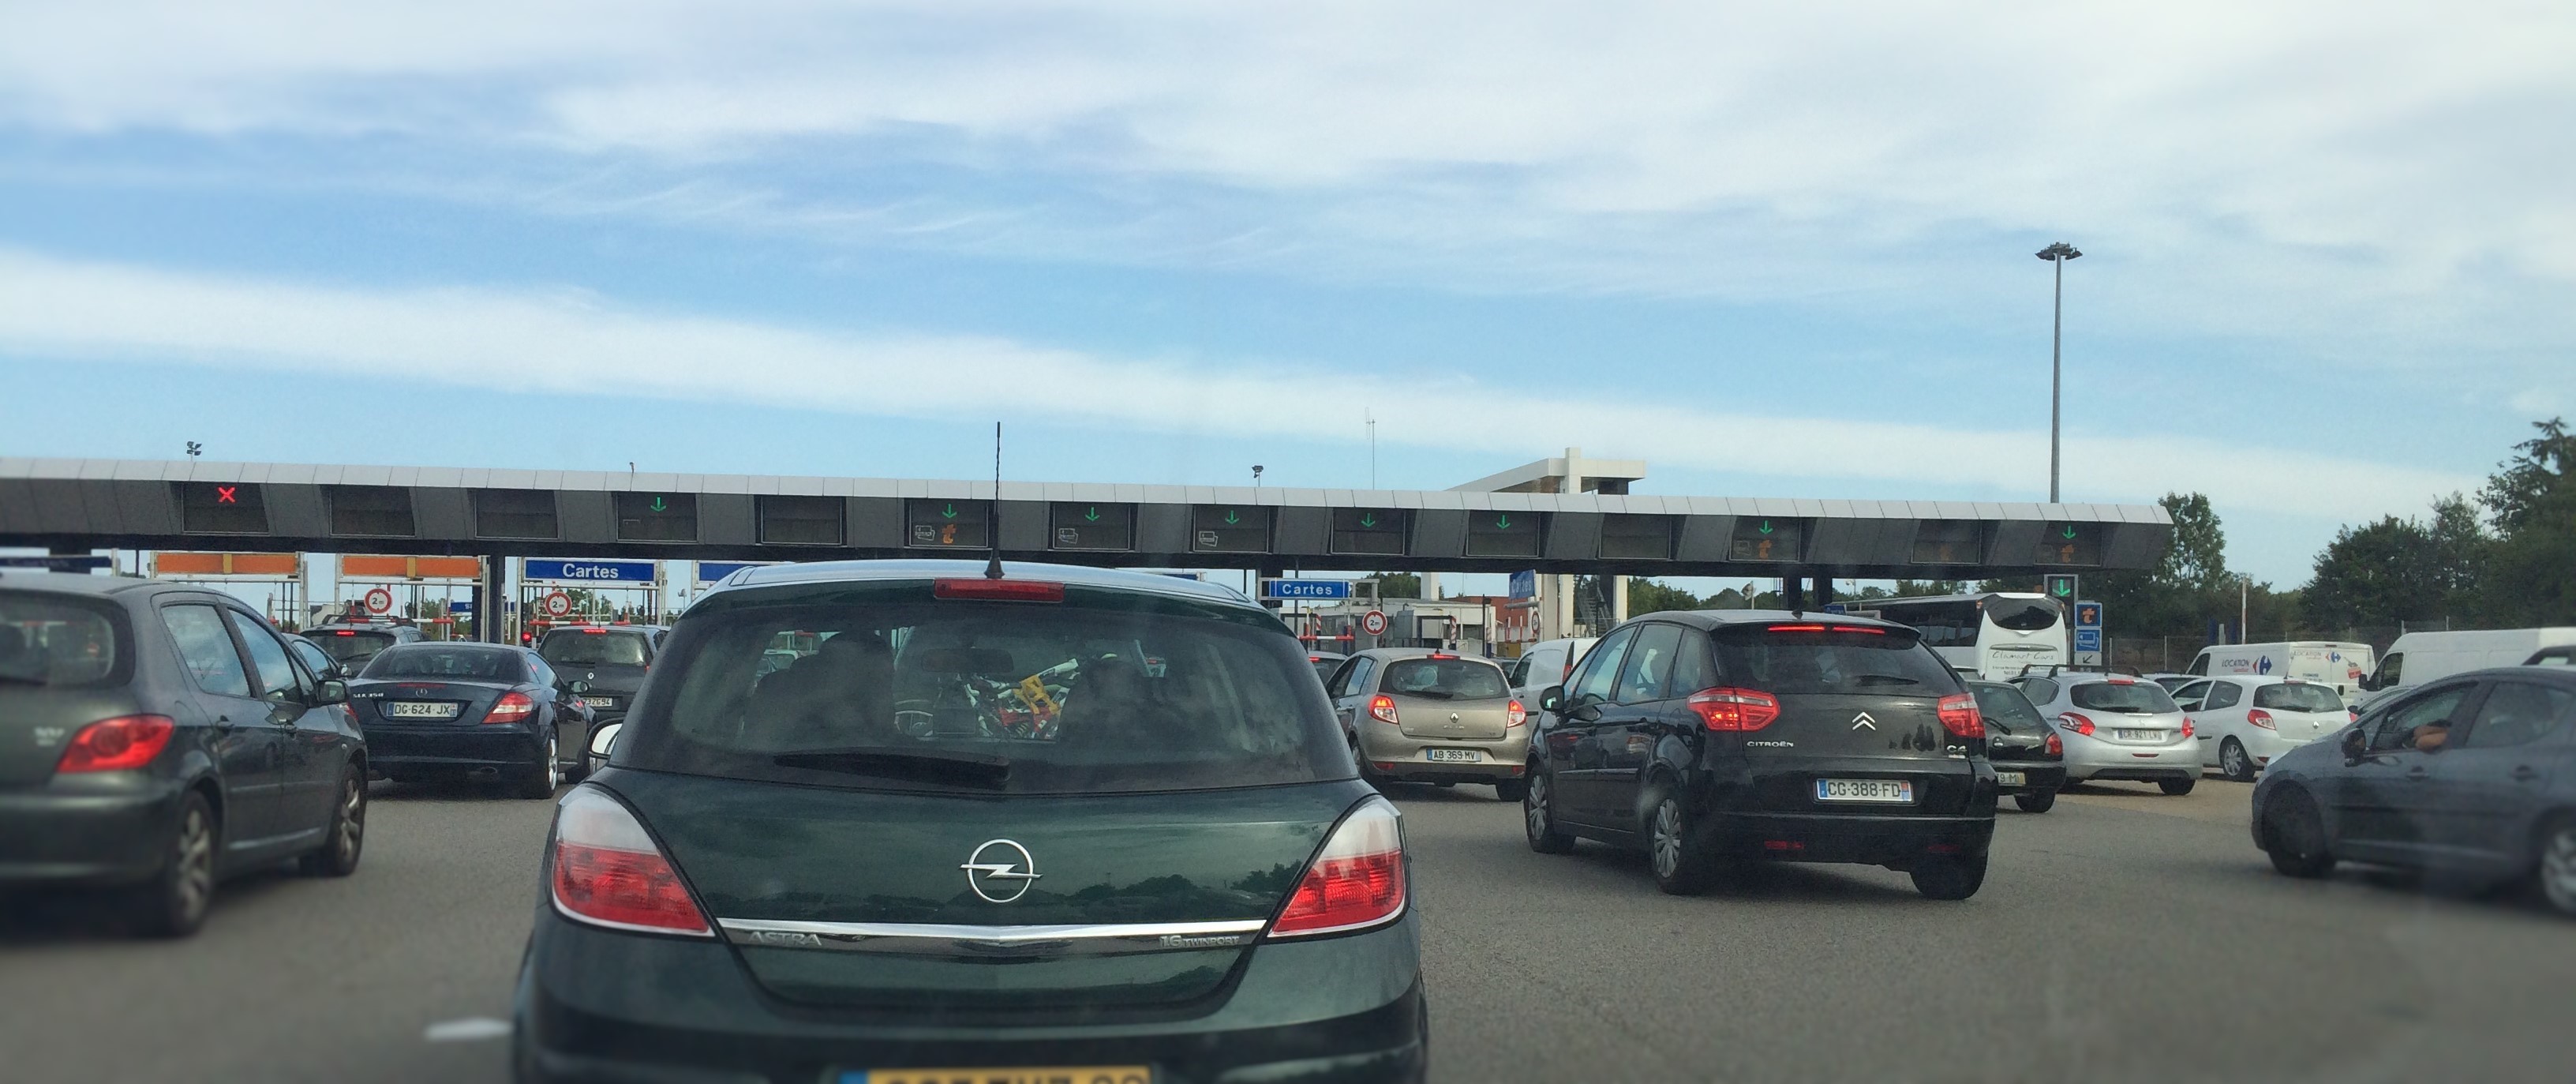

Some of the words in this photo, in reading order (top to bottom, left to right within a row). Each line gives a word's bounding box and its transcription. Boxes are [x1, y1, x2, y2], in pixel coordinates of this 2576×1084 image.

[563, 563, 619, 579] Cartes
[1282, 583, 1333, 595] Cartes
[1828, 782, 1901, 797] CG-388-FD
[748, 932, 822, 946] ASTRA
